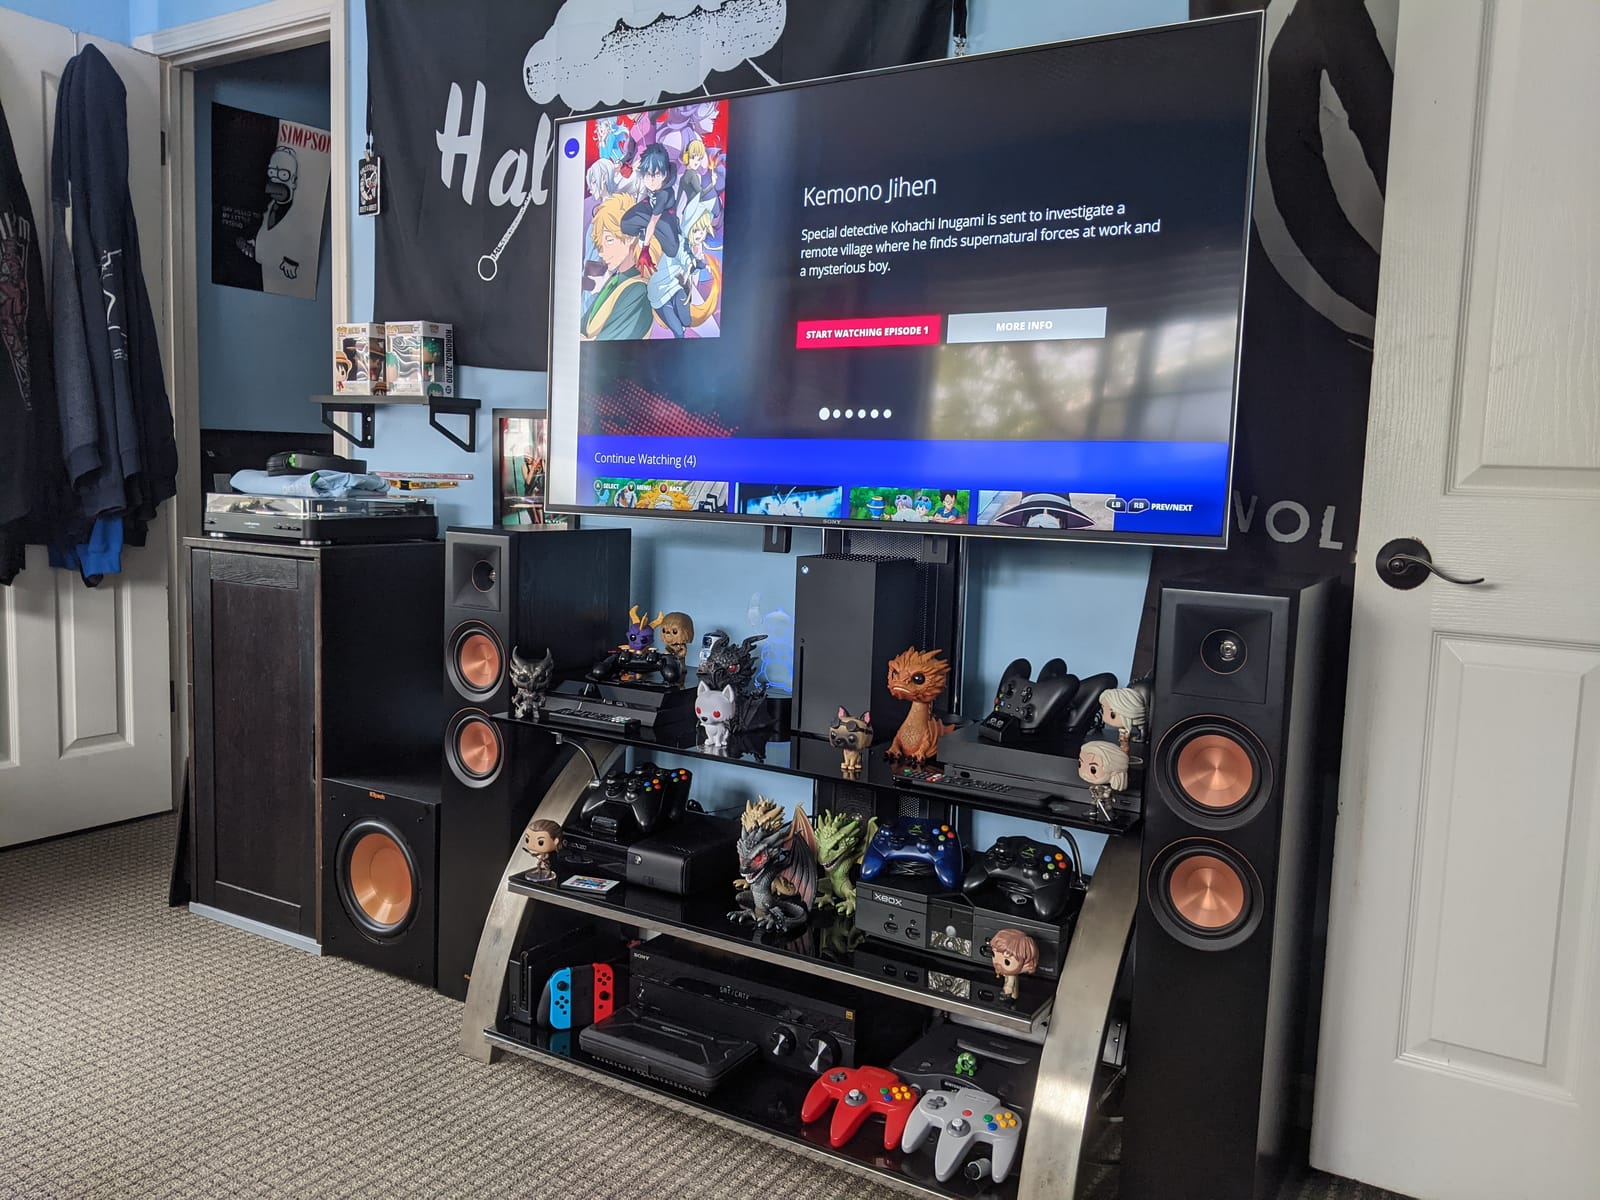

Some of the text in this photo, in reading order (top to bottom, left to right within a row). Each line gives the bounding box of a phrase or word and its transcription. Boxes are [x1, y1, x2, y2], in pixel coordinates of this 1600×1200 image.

[804, 176, 937, 207] Kemono Jihen
[801, 204, 1126, 244] Special detective Kohachi Inugami is sent to investigate a
[800, 218, 1161, 259] remote village where he finds supernatural forces at work and
[799, 260, 891, 280] a mysterious boy.
[805, 325, 930, 339] START WATCHING EPISODE 1
[996, 320, 1053, 332] MORE INFO
[594, 452, 697, 469] Continue Watching (4)
[1151, 503, 1194, 512] PREV/NEXT
[823, 518, 842, 526] SONY
[874, 892, 902, 906] XBOX
[633, 952, 650, 961] SONY
